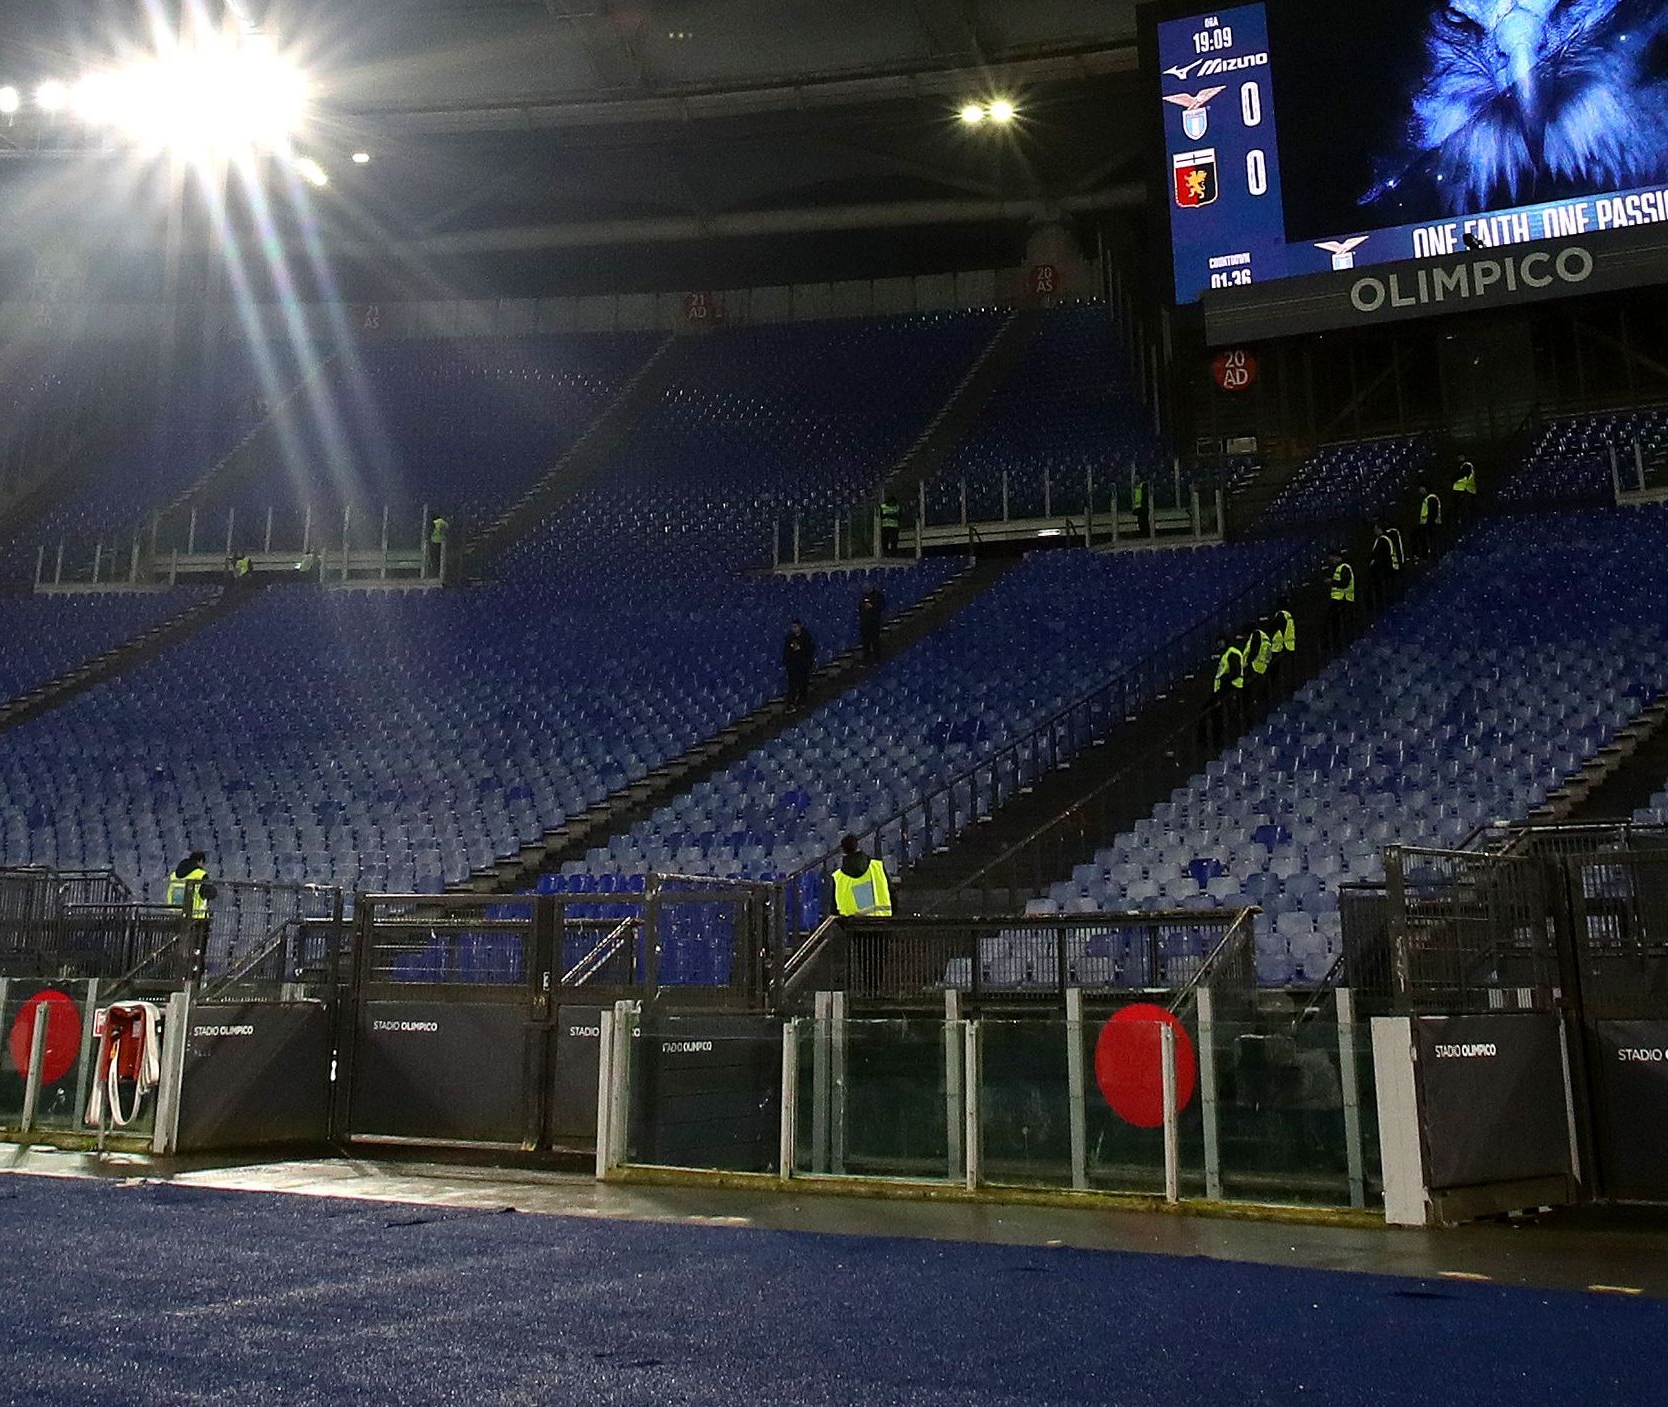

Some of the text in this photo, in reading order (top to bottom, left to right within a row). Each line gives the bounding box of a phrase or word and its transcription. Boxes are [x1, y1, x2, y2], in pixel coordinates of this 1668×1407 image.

[1193, 27, 1233, 53] 19:09
[1240, 81, 1262, 127] 0
[1246, 149, 1268, 196] 0
[1413, 223, 1458, 259] ONE
[1542, 202, 1589, 240] ONE
[1036, 278, 1053, 293] AS
[1350, 246, 1593, 313] OLIMPICO
[690, 293, 705, 306] 21
[688, 305, 708, 320] AD
[1224, 350, 1246, 368] 20
[1223, 367, 1249, 388] AD
[193, 1025, 254, 1037] STADIO OLIMPICO
[373, 1020, 439, 1032] STADIO OLIMPICO
[569, 1026, 600, 1037] STADIO
[1435, 1043, 1497, 1058] STADIO OLIMPICO
[1618, 1048, 1663, 1062] STADIO
